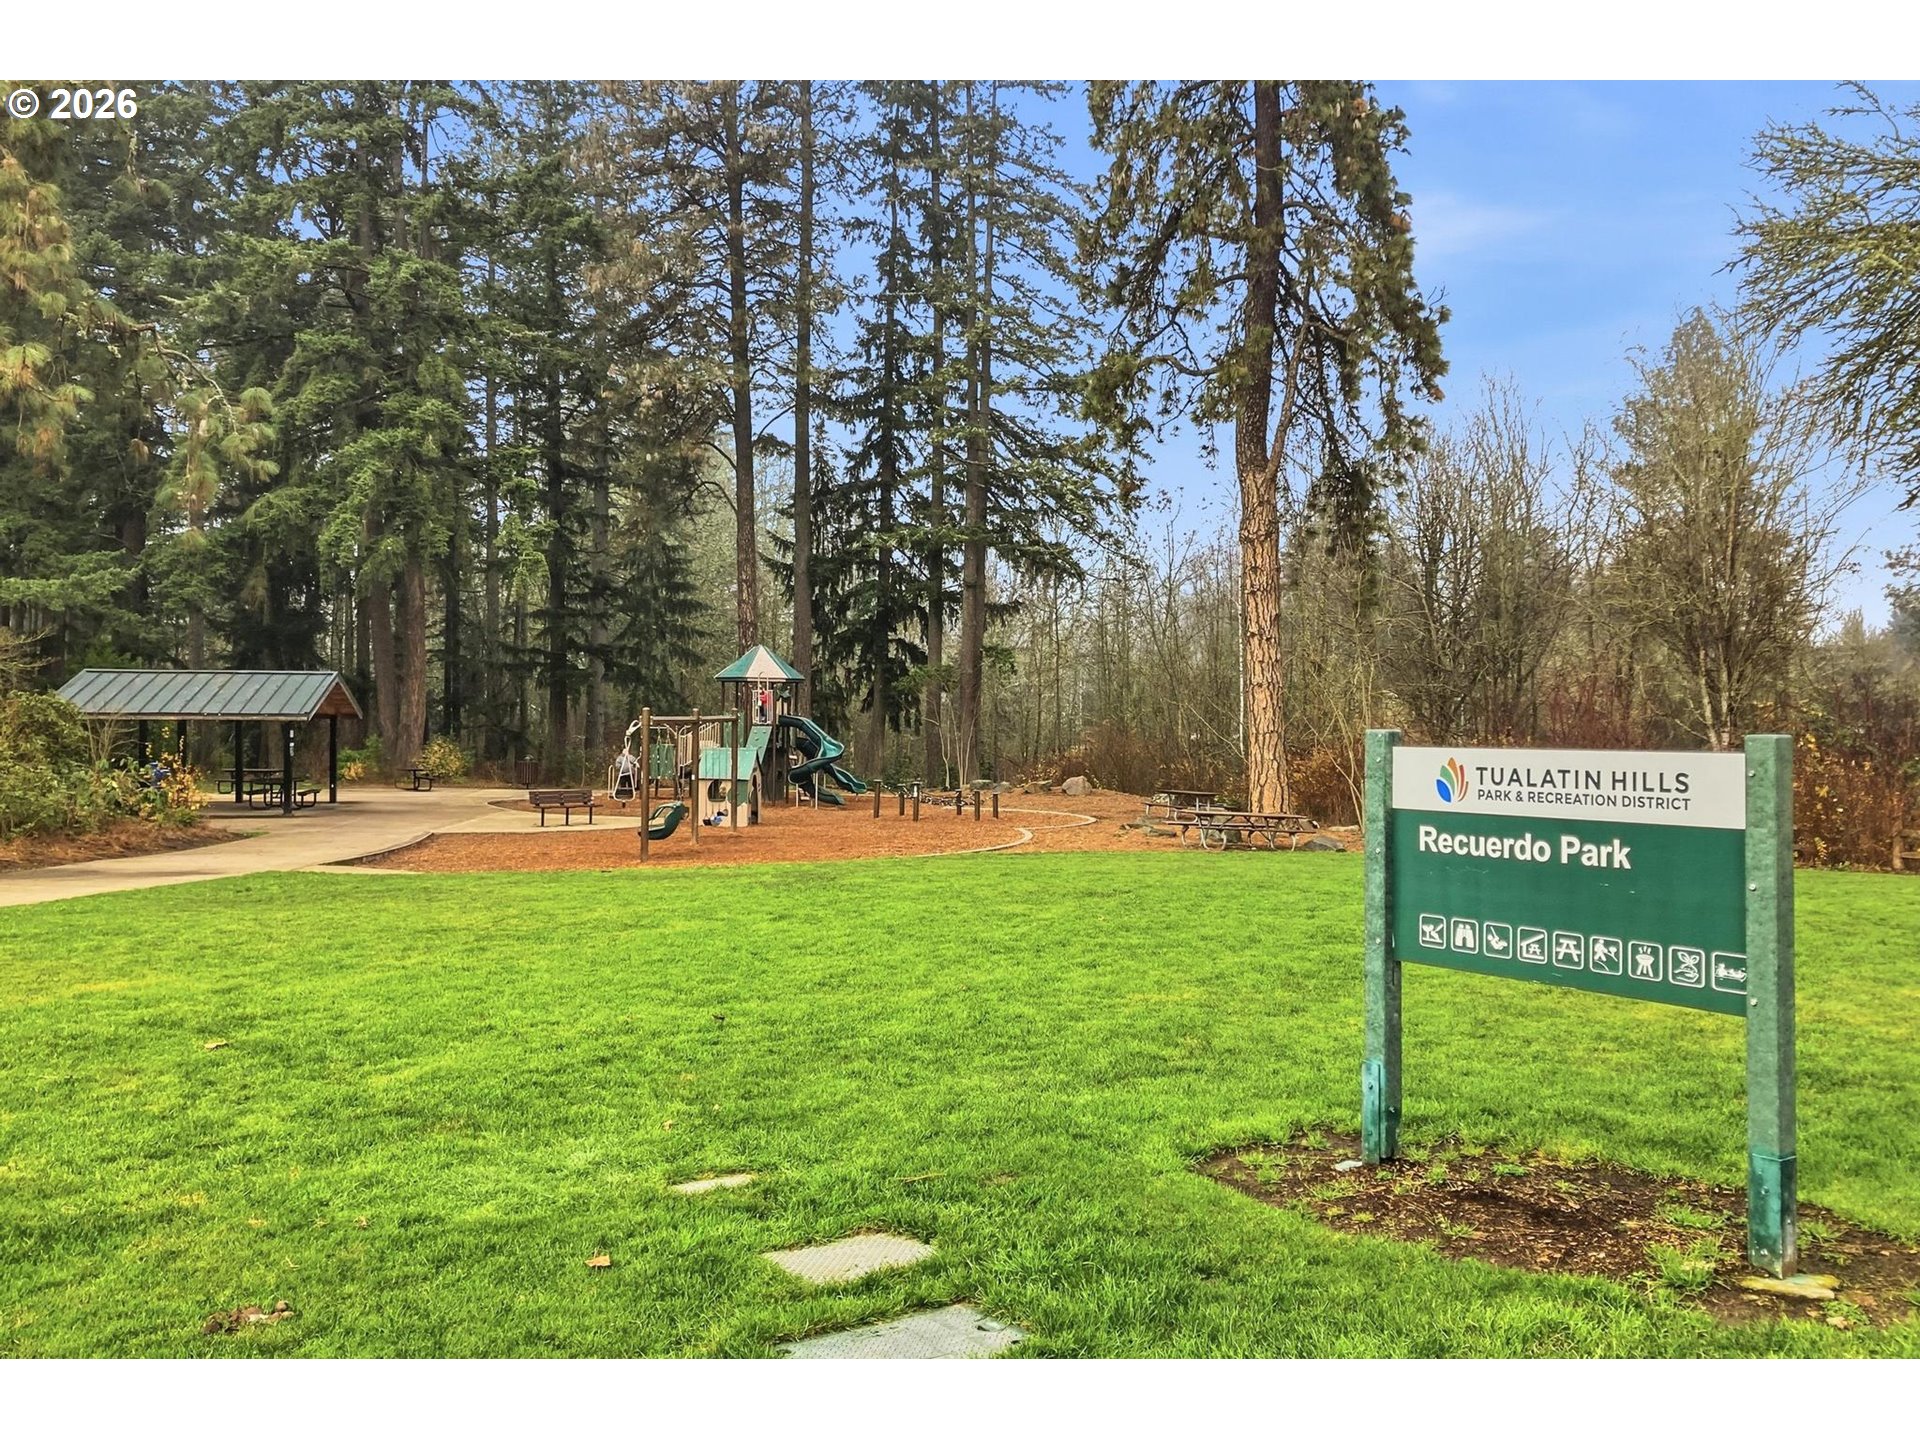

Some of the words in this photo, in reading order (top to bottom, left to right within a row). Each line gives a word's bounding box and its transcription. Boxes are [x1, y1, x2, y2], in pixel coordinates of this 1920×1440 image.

[1475, 767, 1601, 791] TUALATIN
[1611, 770, 1690, 794] HILLS
[1477, 789, 1512, 802] PARK
[1515, 791, 1525, 803] &
[1528, 791, 1617, 807] RECREATION
[1621, 794, 1691, 811] DISTRICT
[1418, 825, 1551, 863] Recuerdo
[1560, 835, 1631, 870] Park
